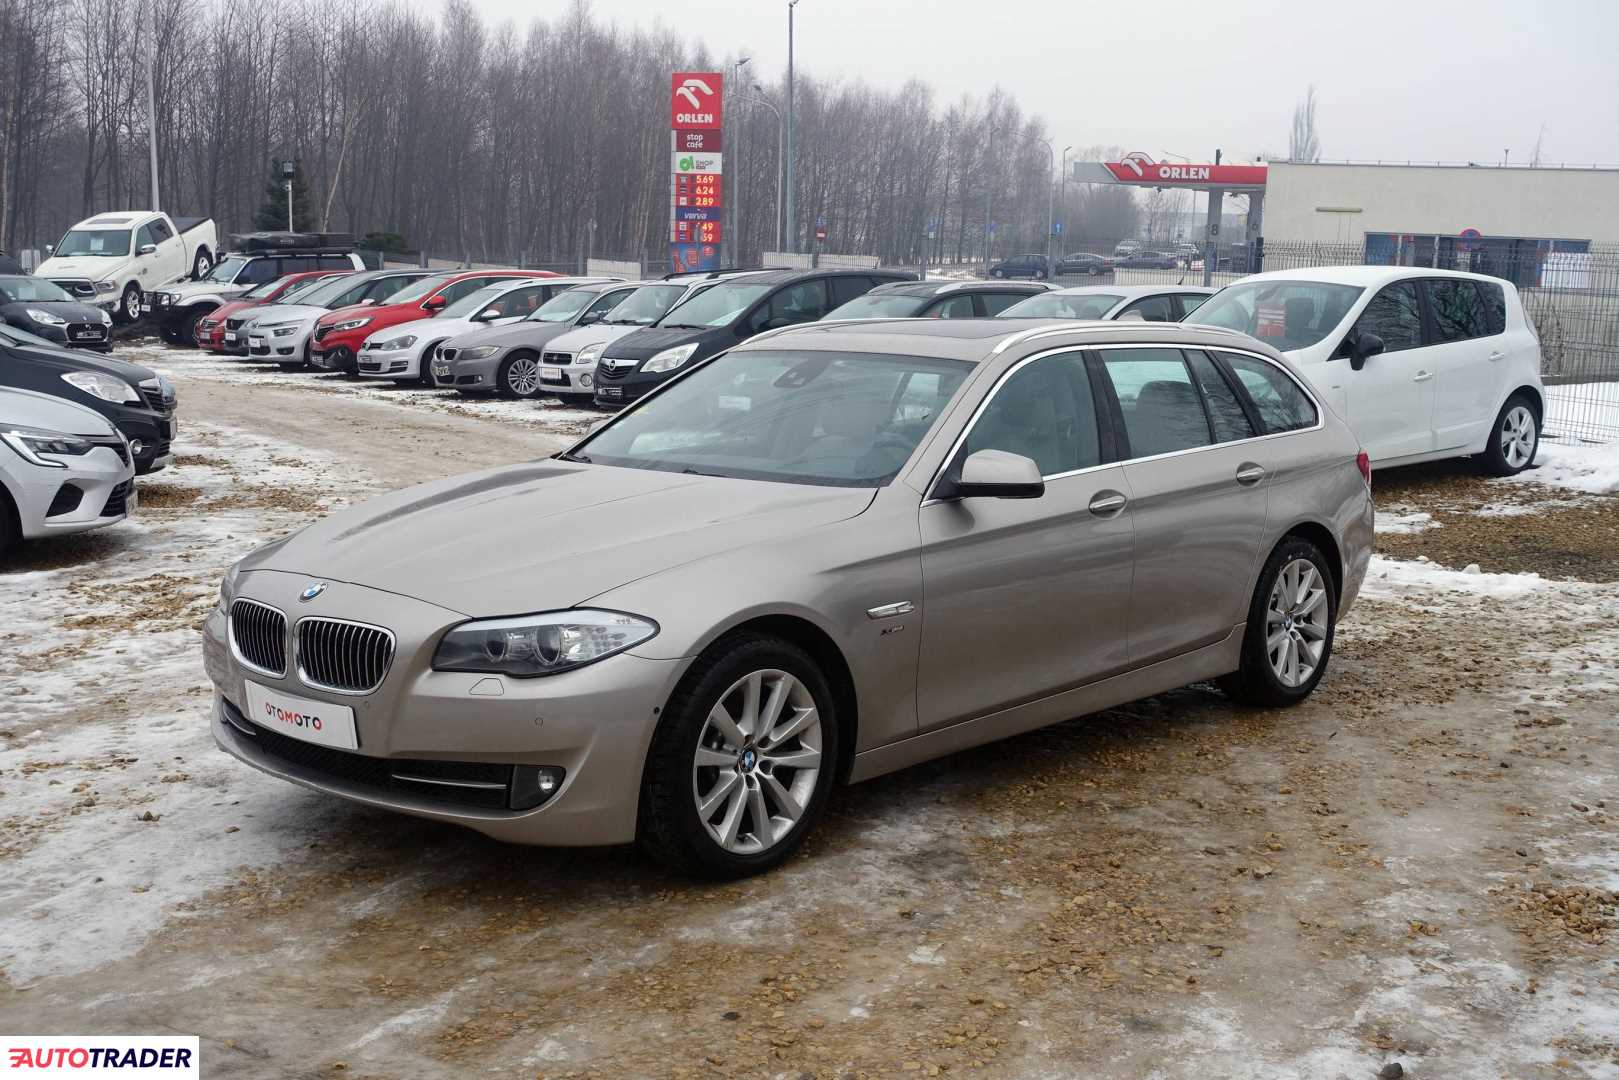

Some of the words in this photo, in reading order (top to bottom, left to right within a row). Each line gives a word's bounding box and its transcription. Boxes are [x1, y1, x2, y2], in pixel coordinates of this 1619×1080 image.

[676, 113, 713, 123] ORLEN
[686, 134, 704, 142] stop
[686, 141, 704, 149] cafe
[1158, 167, 1210, 180] ORLEN
[265, 702, 323, 731] OTOMOTO
